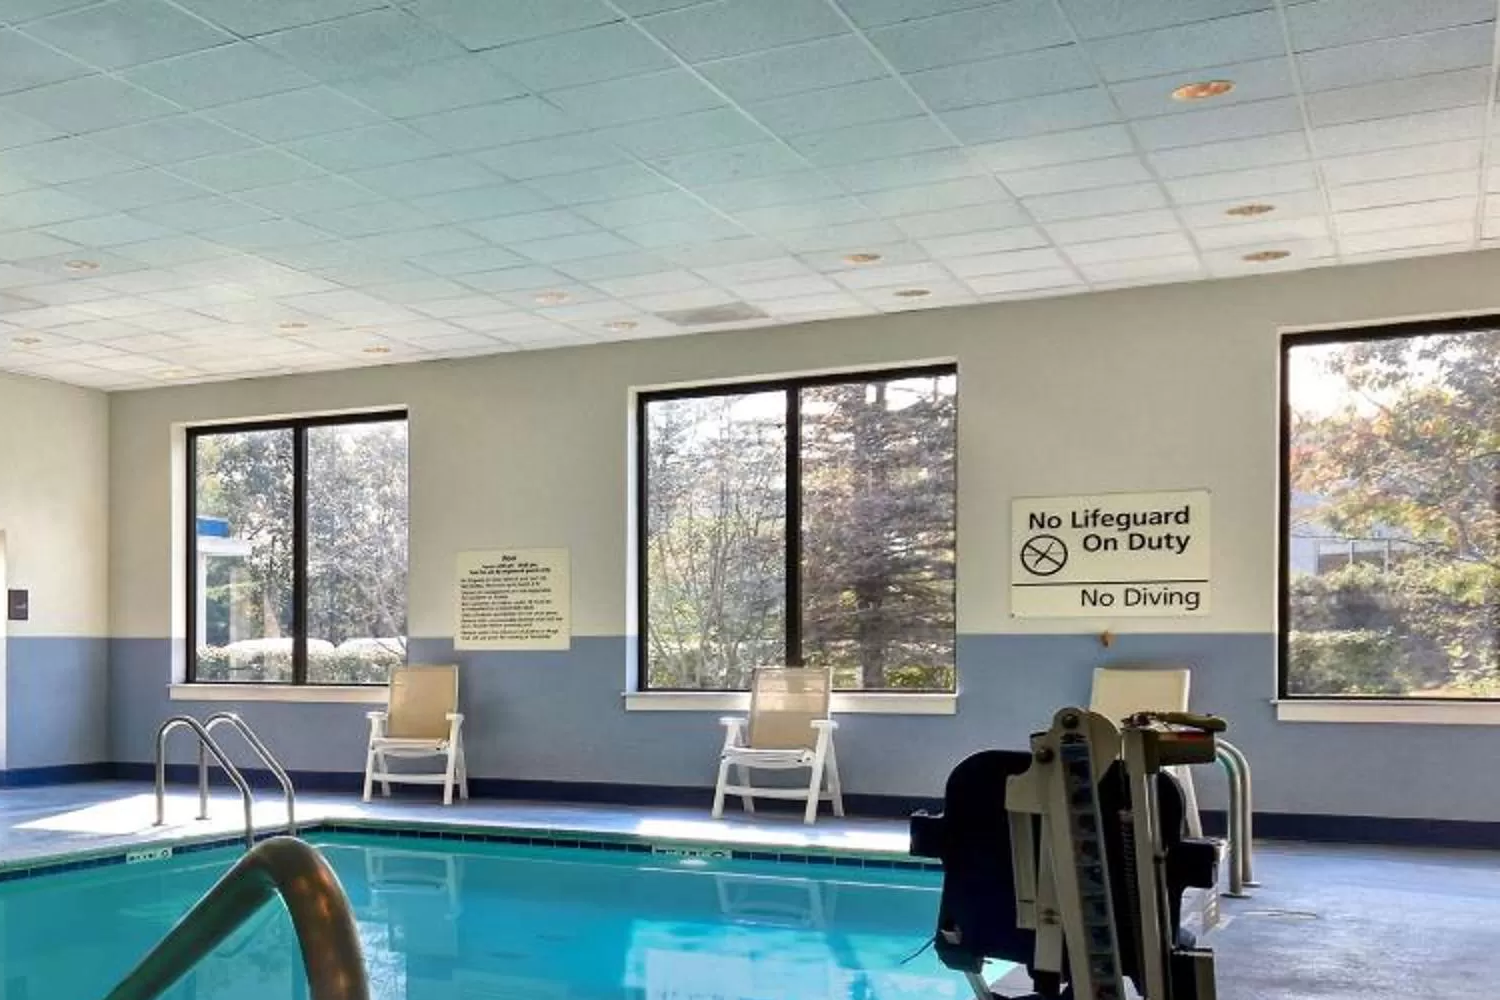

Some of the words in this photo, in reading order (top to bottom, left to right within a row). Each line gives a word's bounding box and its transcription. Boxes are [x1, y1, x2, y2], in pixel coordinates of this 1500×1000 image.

[1029, 512, 1062, 530] No
[1071, 505, 1190, 532] Lifeguard
[1082, 533, 1118, 552] On
[1128, 533, 1191, 554] Duty
[1081, 589, 1115, 607] No
[1124, 587, 1200, 611] Diving
